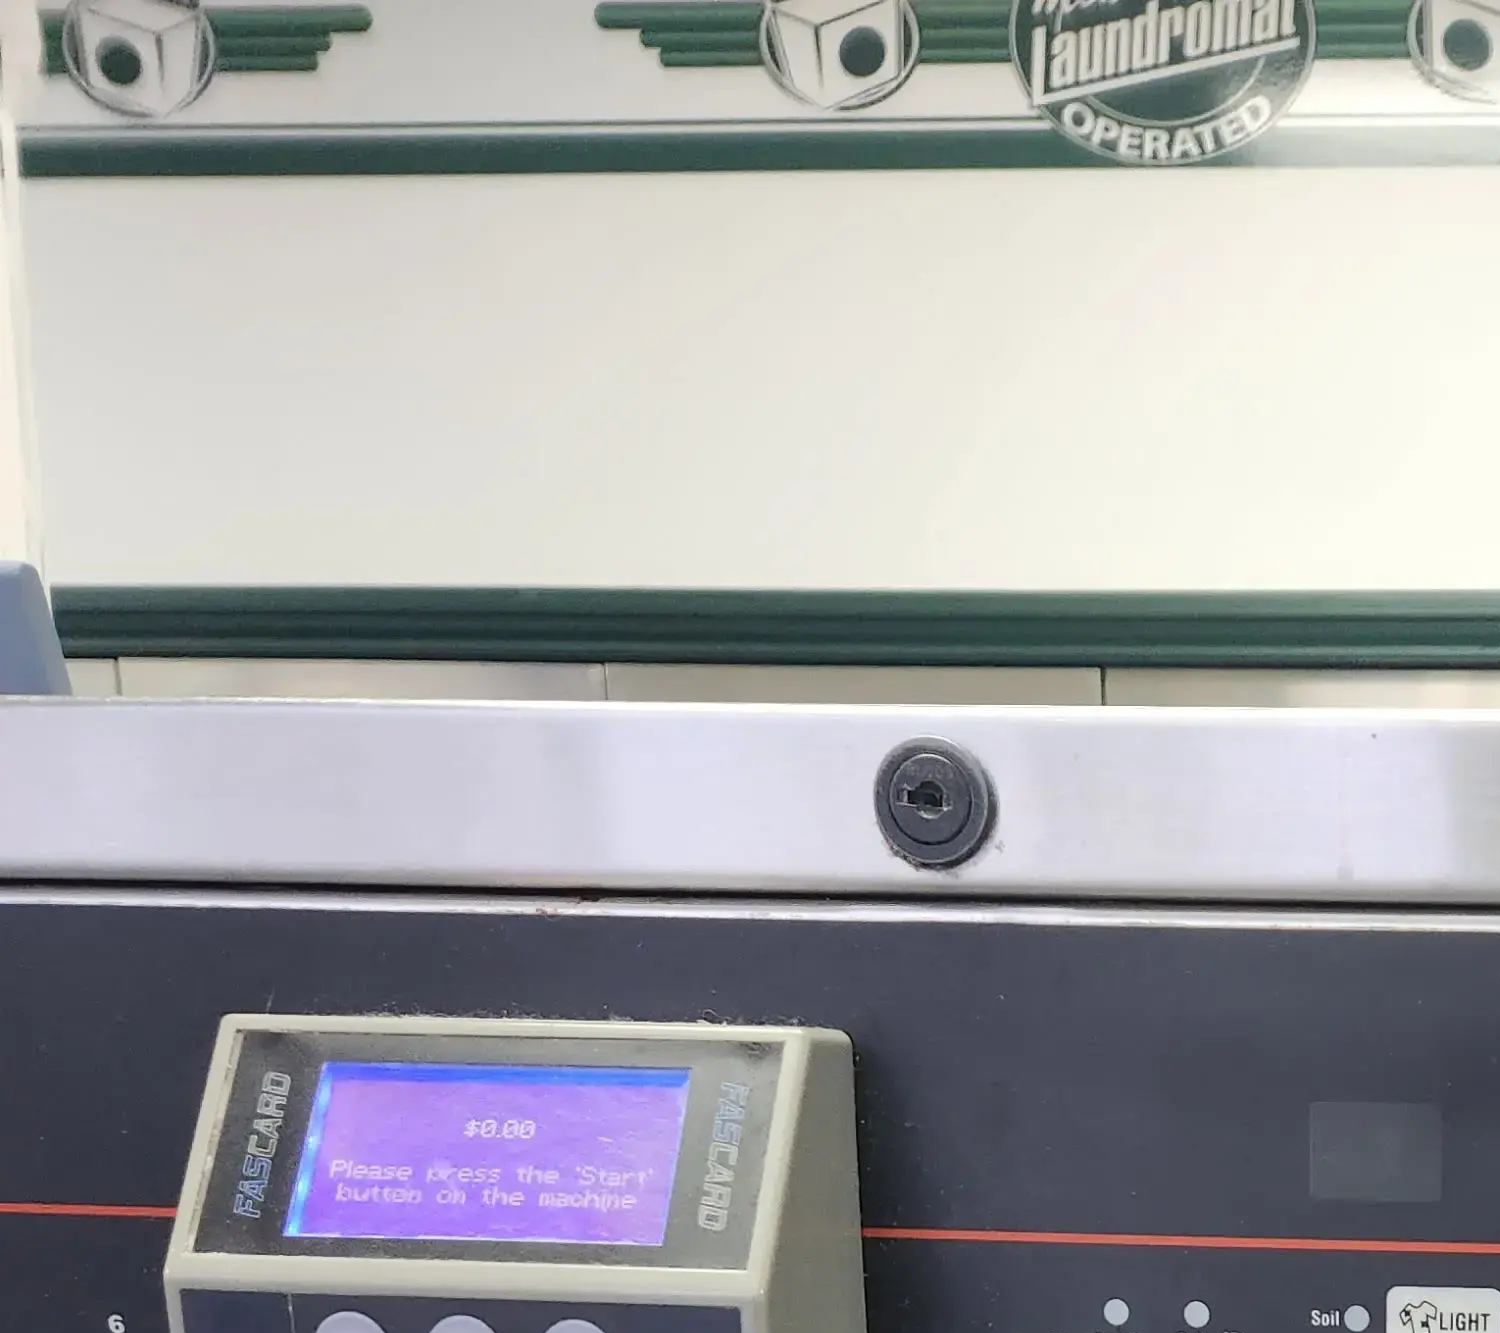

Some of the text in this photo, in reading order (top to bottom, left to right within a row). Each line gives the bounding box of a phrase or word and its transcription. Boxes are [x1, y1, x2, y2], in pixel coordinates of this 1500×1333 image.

[1061, 95, 1273, 160] OPERATED
[463, 1118, 536, 1140] $0.00
[233, 1070, 293, 1219] FASCARD
[697, 1081, 751, 1233] FASCARD
[329, 1160, 413, 1184] Please
[425, 1166, 502, 1188] press
[516, 1164, 560, 1185] the
[335, 1181, 638, 1210] button on the machine
[1311, 1309, 1341, 1328] Soil
[1438, 1312, 1491, 1333] LIGHT
